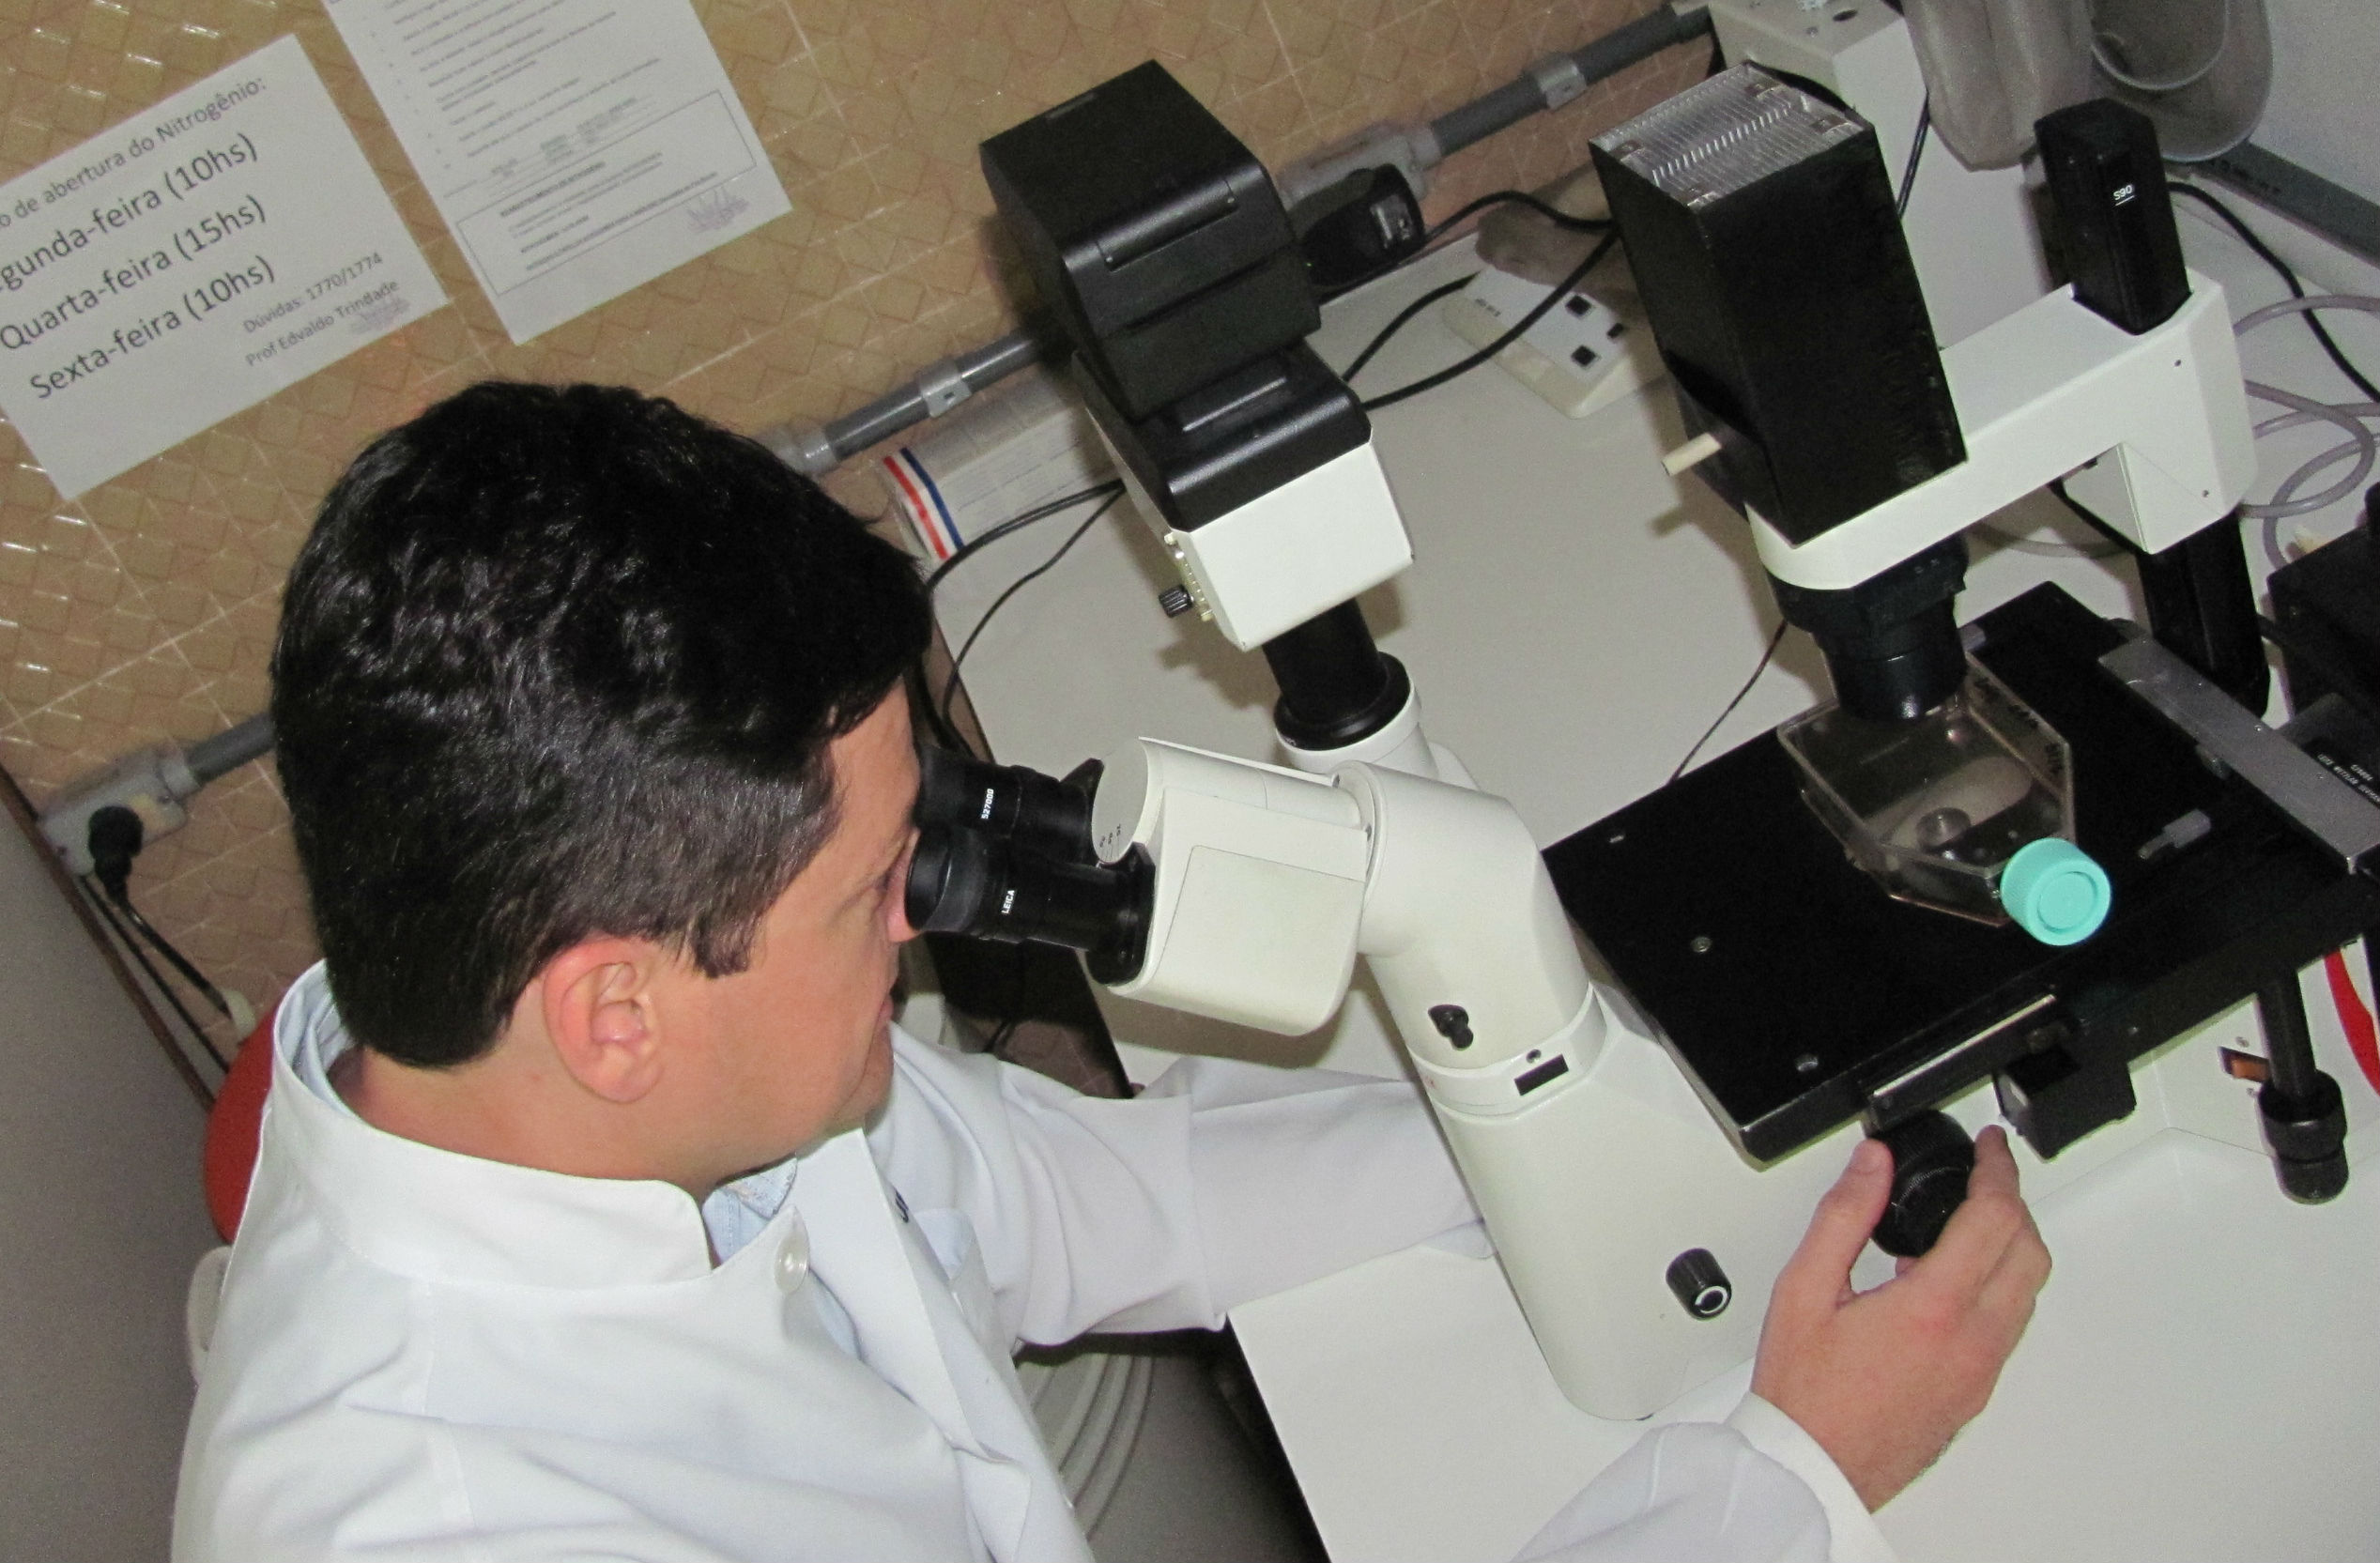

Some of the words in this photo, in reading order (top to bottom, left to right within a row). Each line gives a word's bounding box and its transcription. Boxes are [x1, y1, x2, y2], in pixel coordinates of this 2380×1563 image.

[14, 196, 39, 219] de
[42, 152, 126, 204] abertura
[129, 136, 155, 159] do
[155, 77, 267, 142] Nitrogênio:
[2113, 184, 2134, 201] S90
[0, 190, 162, 291] gunda-feira
[164, 132, 257, 201] (10hs)
[0, 250, 172, 349] Quarta-feira
[174, 194, 266, 261] (15hs)
[30, 310, 181, 399] Sexta-feira
[184, 255, 274, 322] (10hs)
[246, 341, 278, 366] Prof
[278, 314, 335, 350] Edvaldo
[334, 281, 400, 317] Trindade
[980, 788, 994, 820] 527000
[1001, 889, 1016, 914] LEICA
